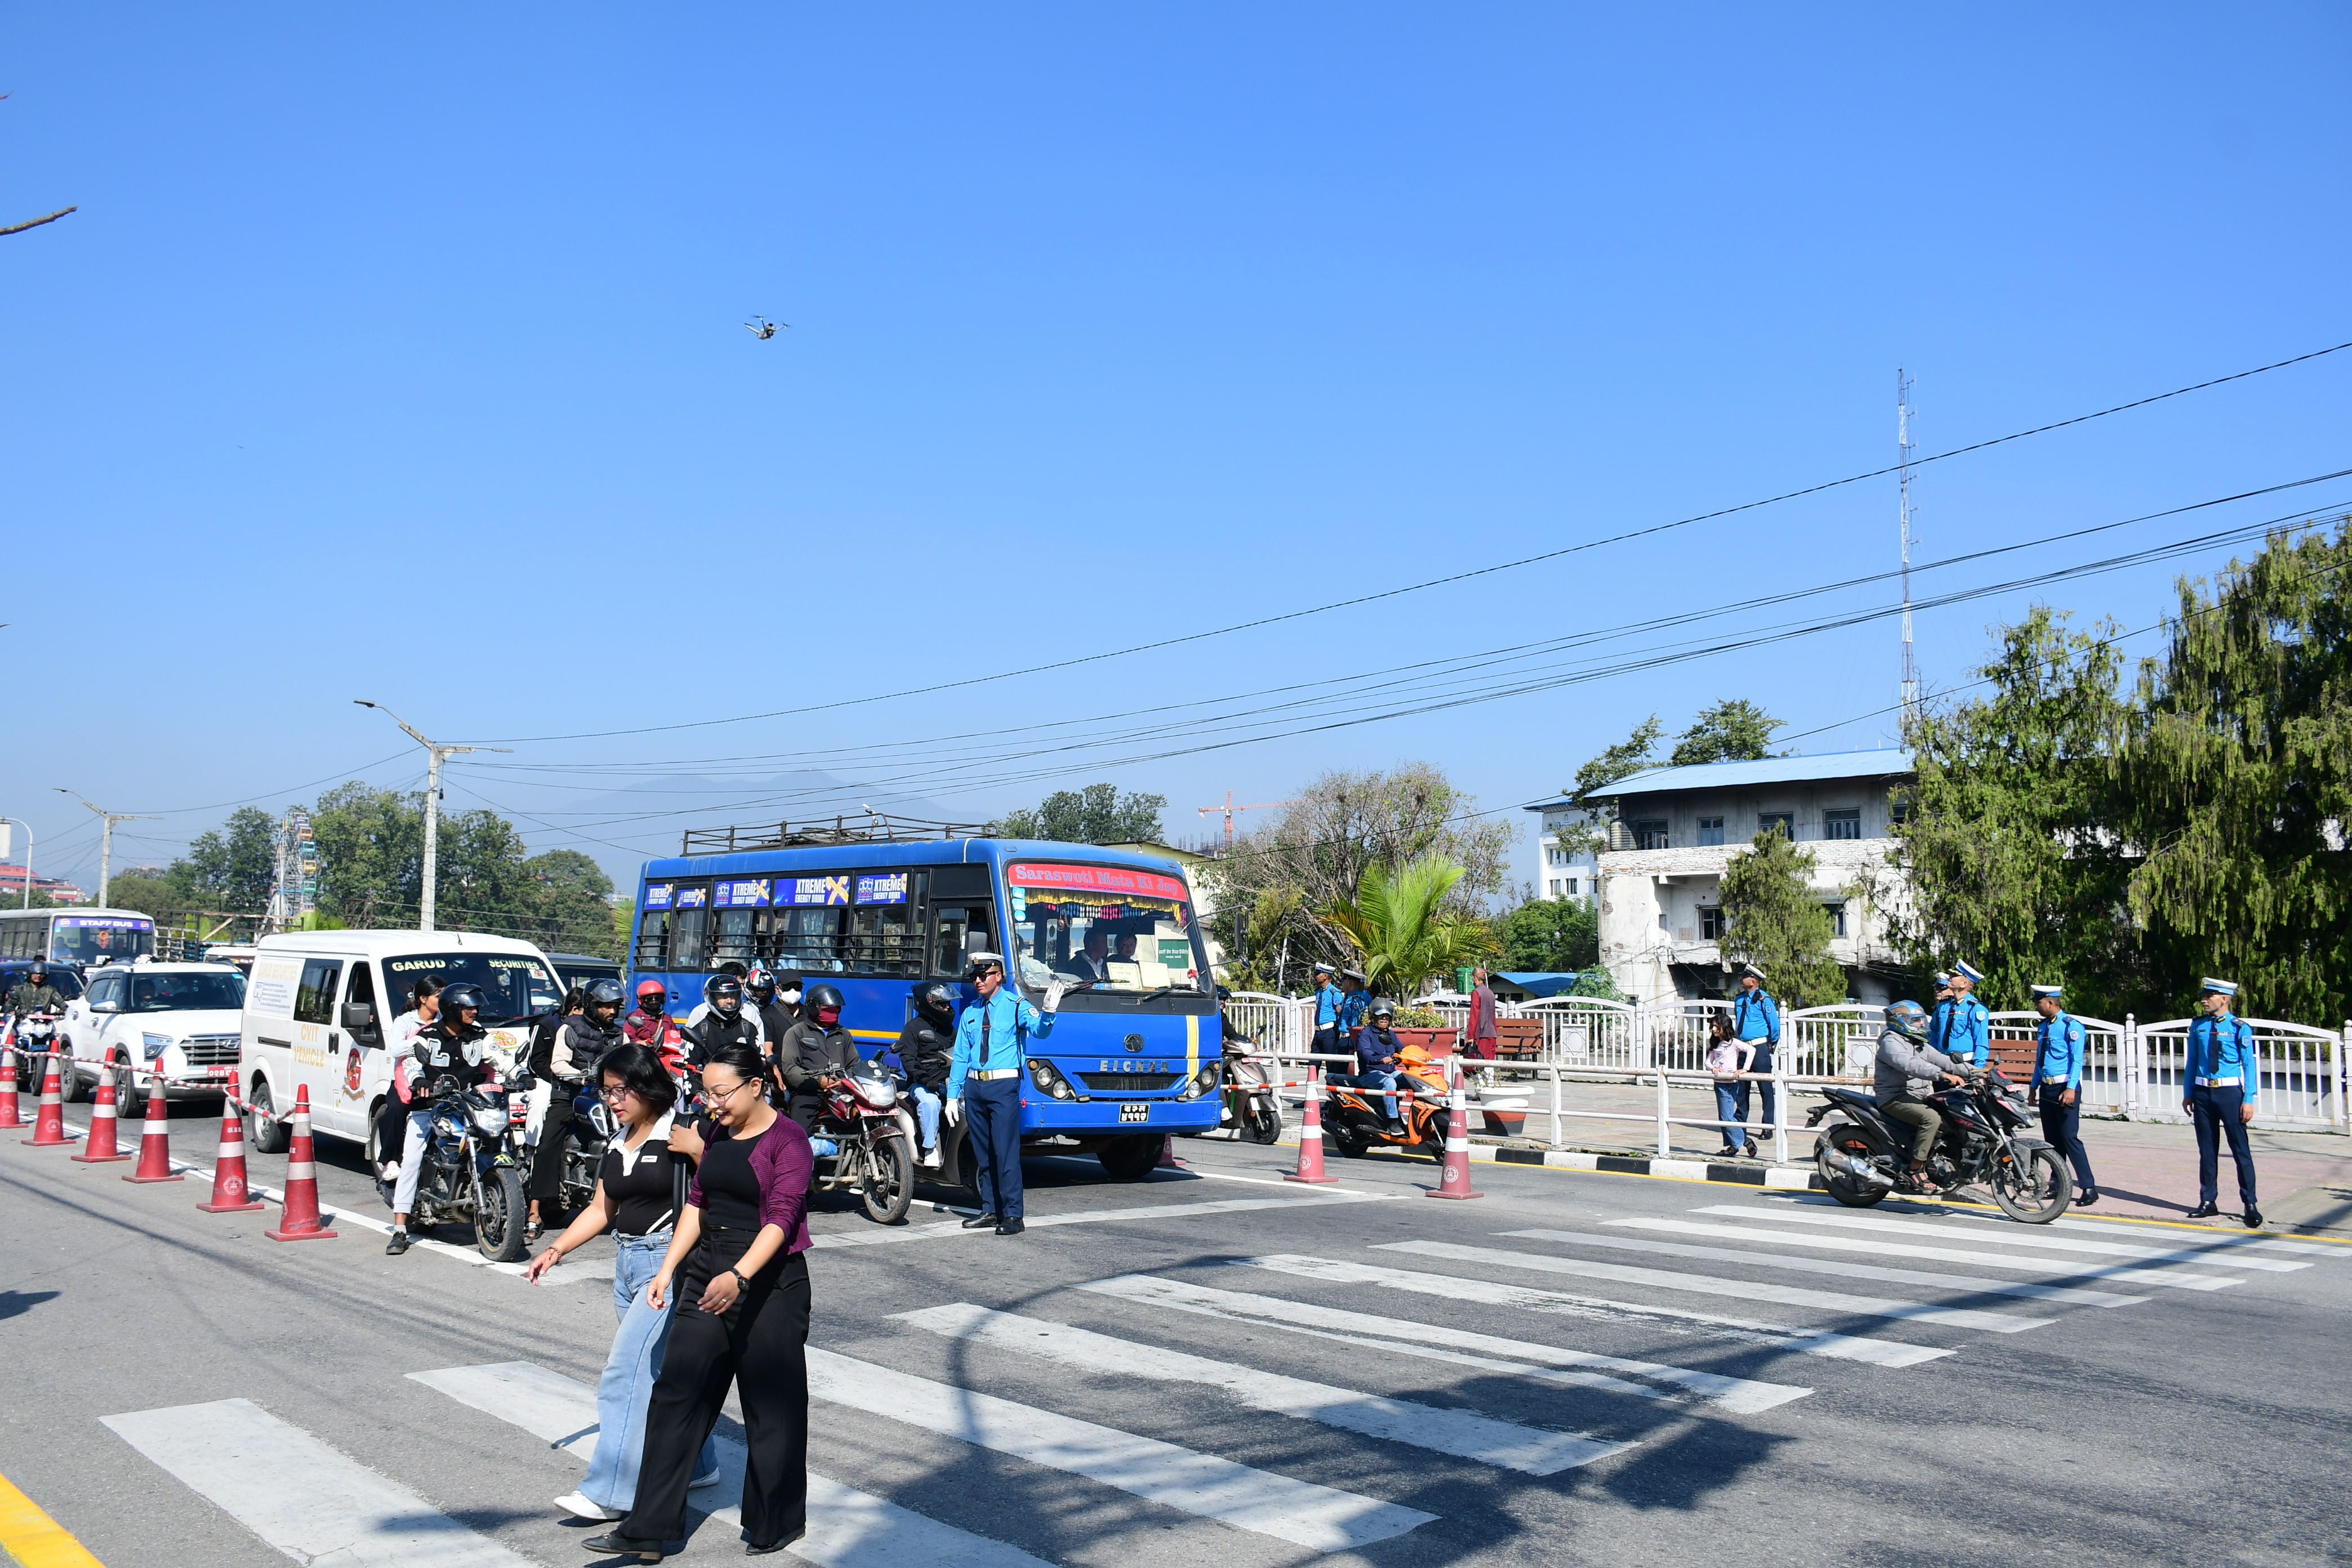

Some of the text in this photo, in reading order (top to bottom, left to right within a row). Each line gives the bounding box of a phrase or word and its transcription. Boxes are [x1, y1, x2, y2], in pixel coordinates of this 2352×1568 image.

[795, 879, 826, 894] XTREME
[874, 879, 902, 892] XTREME
[1015, 866, 1178, 896] Saraswoti Mata Ki Jay
[649, 888, 668, 898] XTREME
[733, 883, 757, 896] XTREME
[873, 891, 901, 900] ENERGY DRINK
[795, 894, 825, 903] ENERGY DRINK
[391, 959, 540, 972] GARUD SECURITIES
[301, 1024, 319, 1042] CVIT
[294, 1045, 325, 1067] VEHICLE
[1099, 1059, 1169, 1073] EICHER
